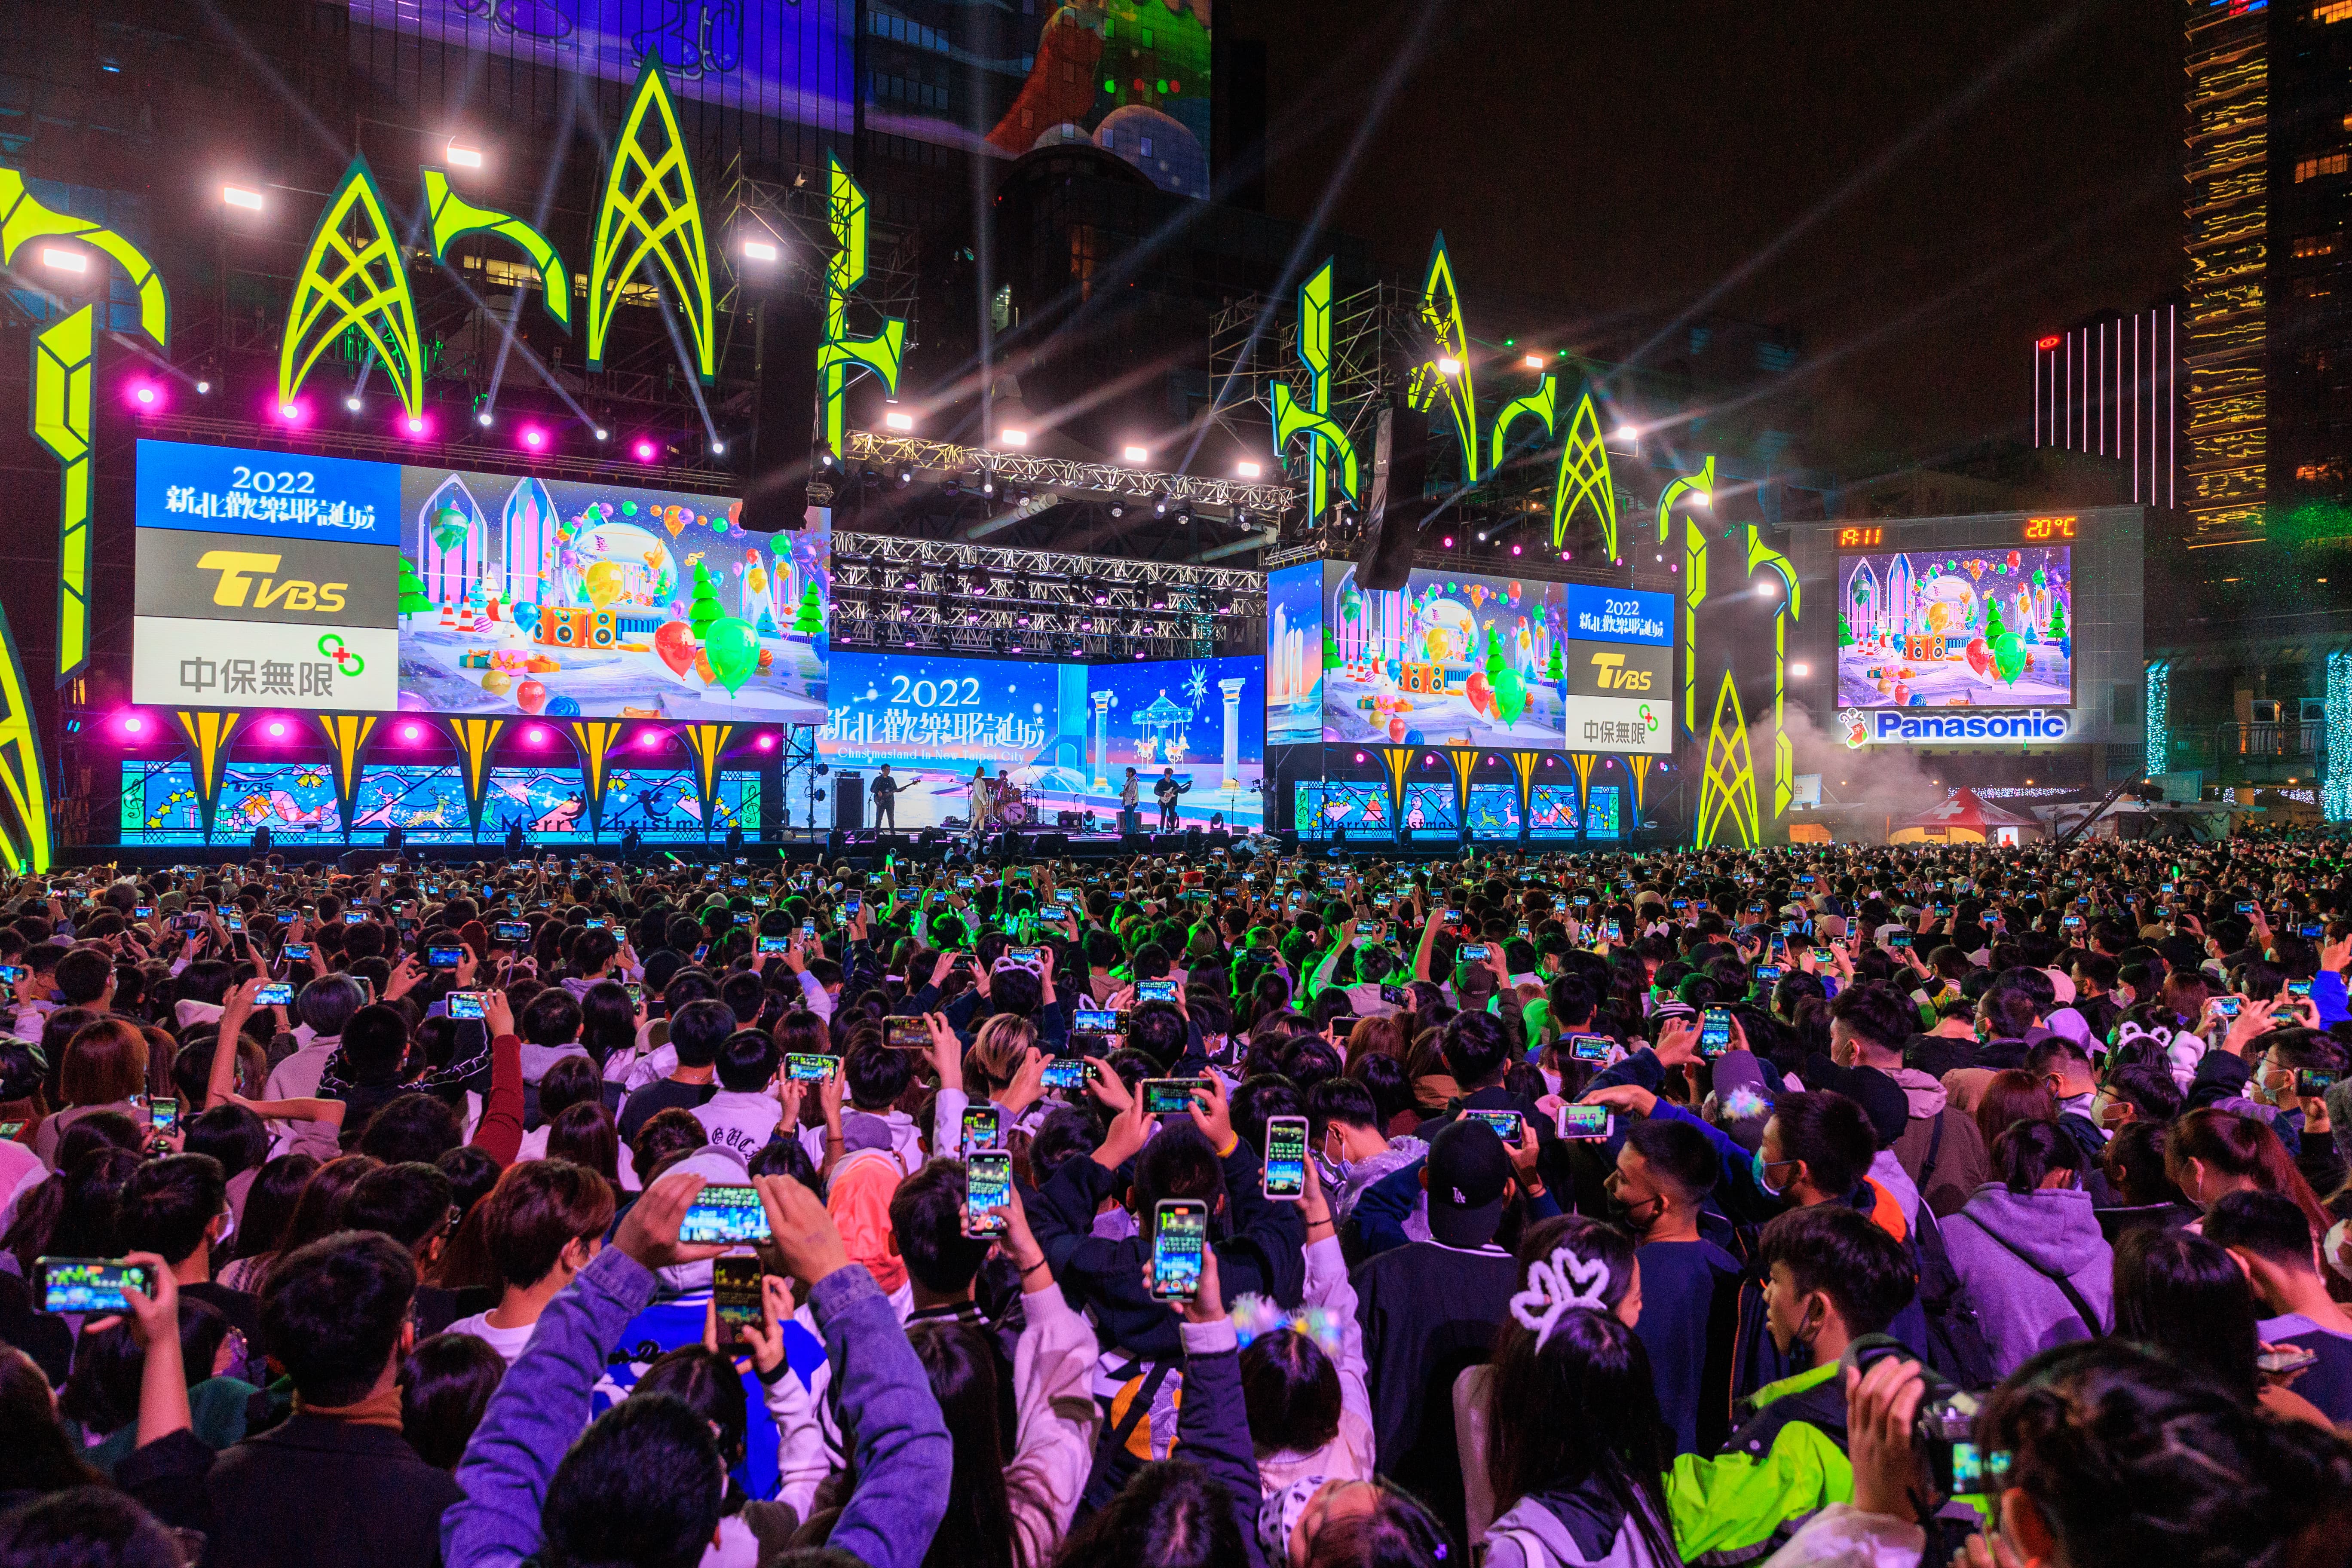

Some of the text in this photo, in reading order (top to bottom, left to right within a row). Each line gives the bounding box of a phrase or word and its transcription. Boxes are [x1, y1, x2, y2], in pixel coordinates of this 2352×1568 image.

[233, 466, 315, 494] 2022
[165, 485, 376, 531] 新北歡樂耶誕城
[1841, 528, 1880, 545] 19:11
[196, 550, 349, 612] TVBS
[1605, 599, 1639, 616] 2022
[180, 656, 333, 697] 中保無限
[1591, 652, 1652, 691] TVBS
[891, 675, 980, 707] 2022
[1584, 719, 1645, 744] 中保無限
[1876, 709, 2067, 740] Panasonic
[922, 749, 931, 760] In
[935, 750, 959, 760] New
[963, 750, 997, 763] Taipei
[1001, 751, 1024, 764] City
[231, 780, 274, 792] TVBS
[502, 813, 581, 836] Merry
